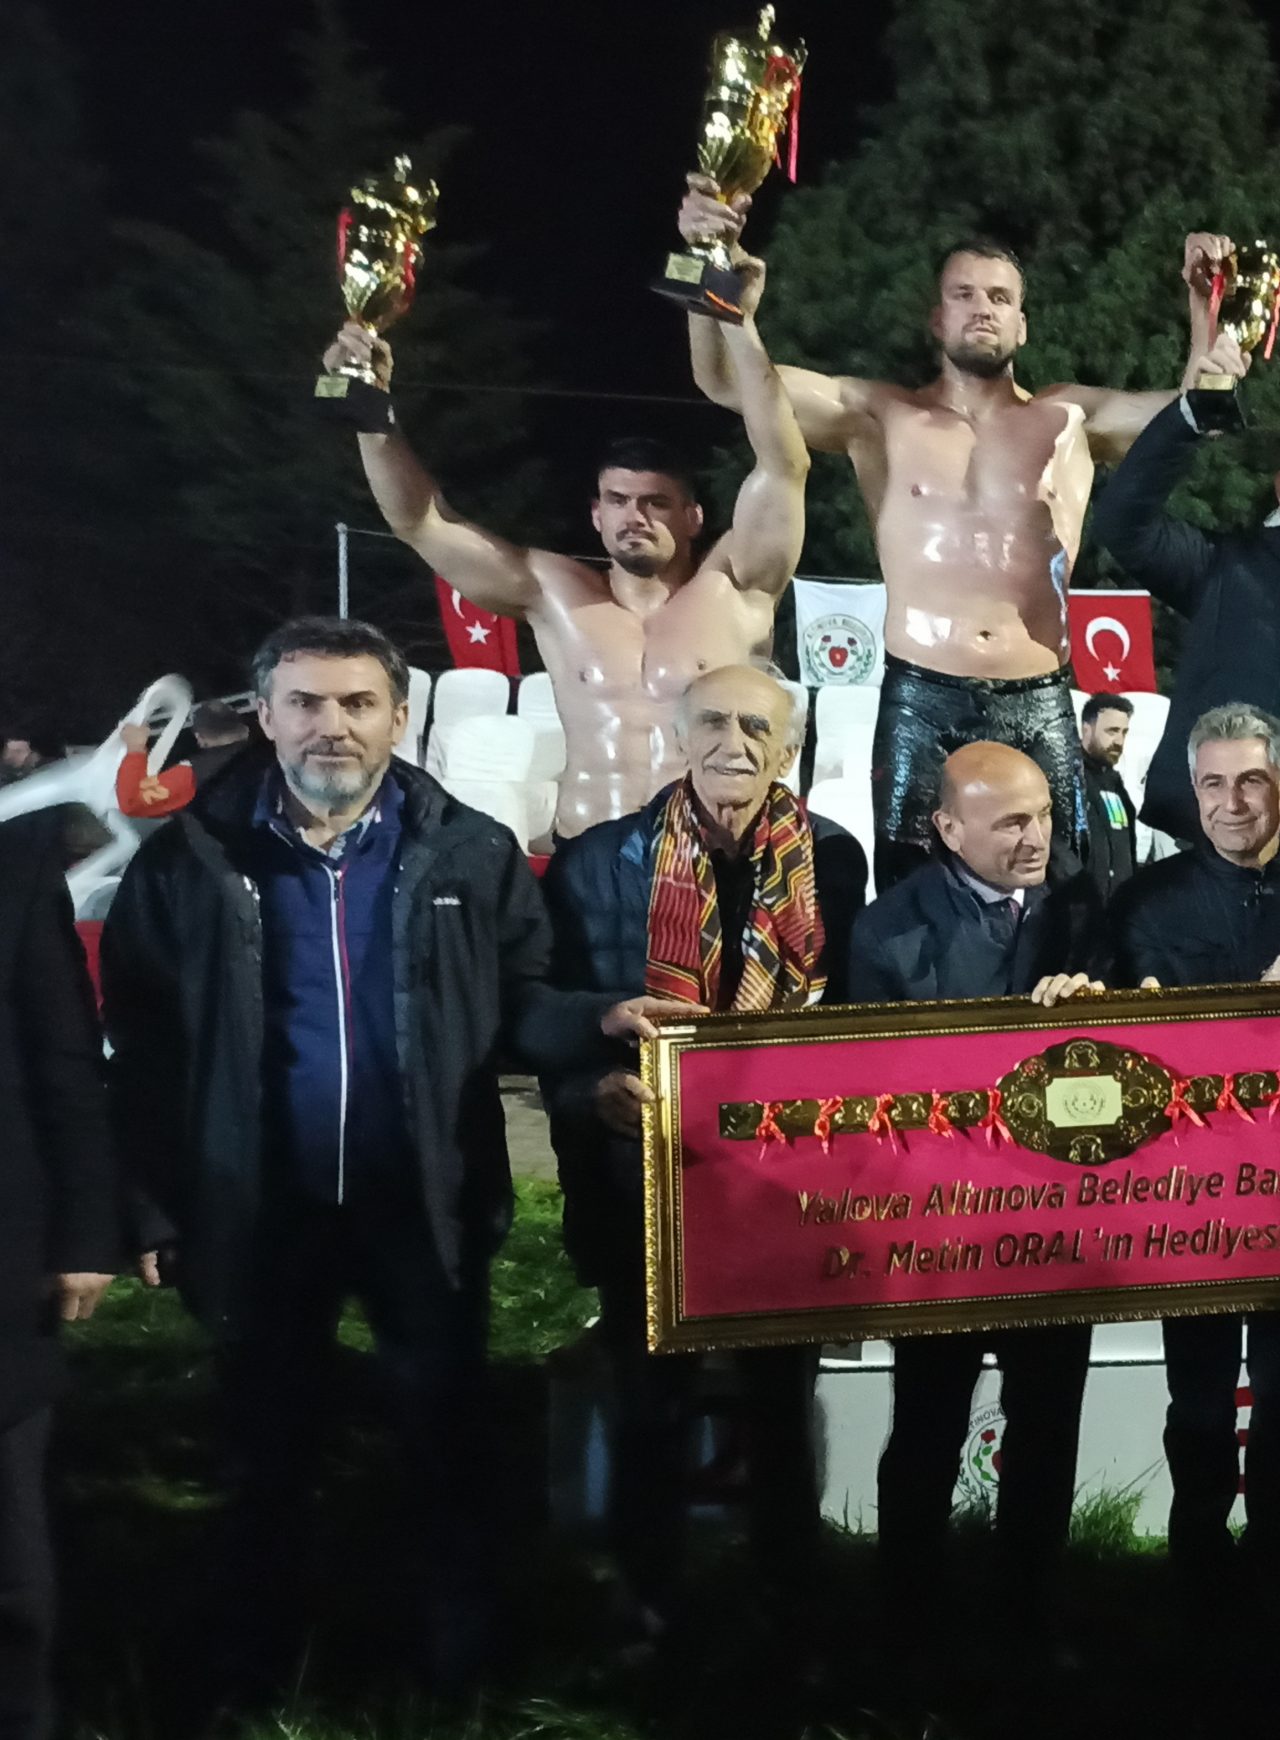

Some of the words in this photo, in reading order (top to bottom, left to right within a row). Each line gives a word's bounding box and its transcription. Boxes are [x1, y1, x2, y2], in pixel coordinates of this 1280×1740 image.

[798, 1188, 912, 1226] Yalova
[1077, 1164, 1225, 1206] Belediye
[825, 1245, 871, 1279] Dr.
[887, 1237, 983, 1275] Metin
